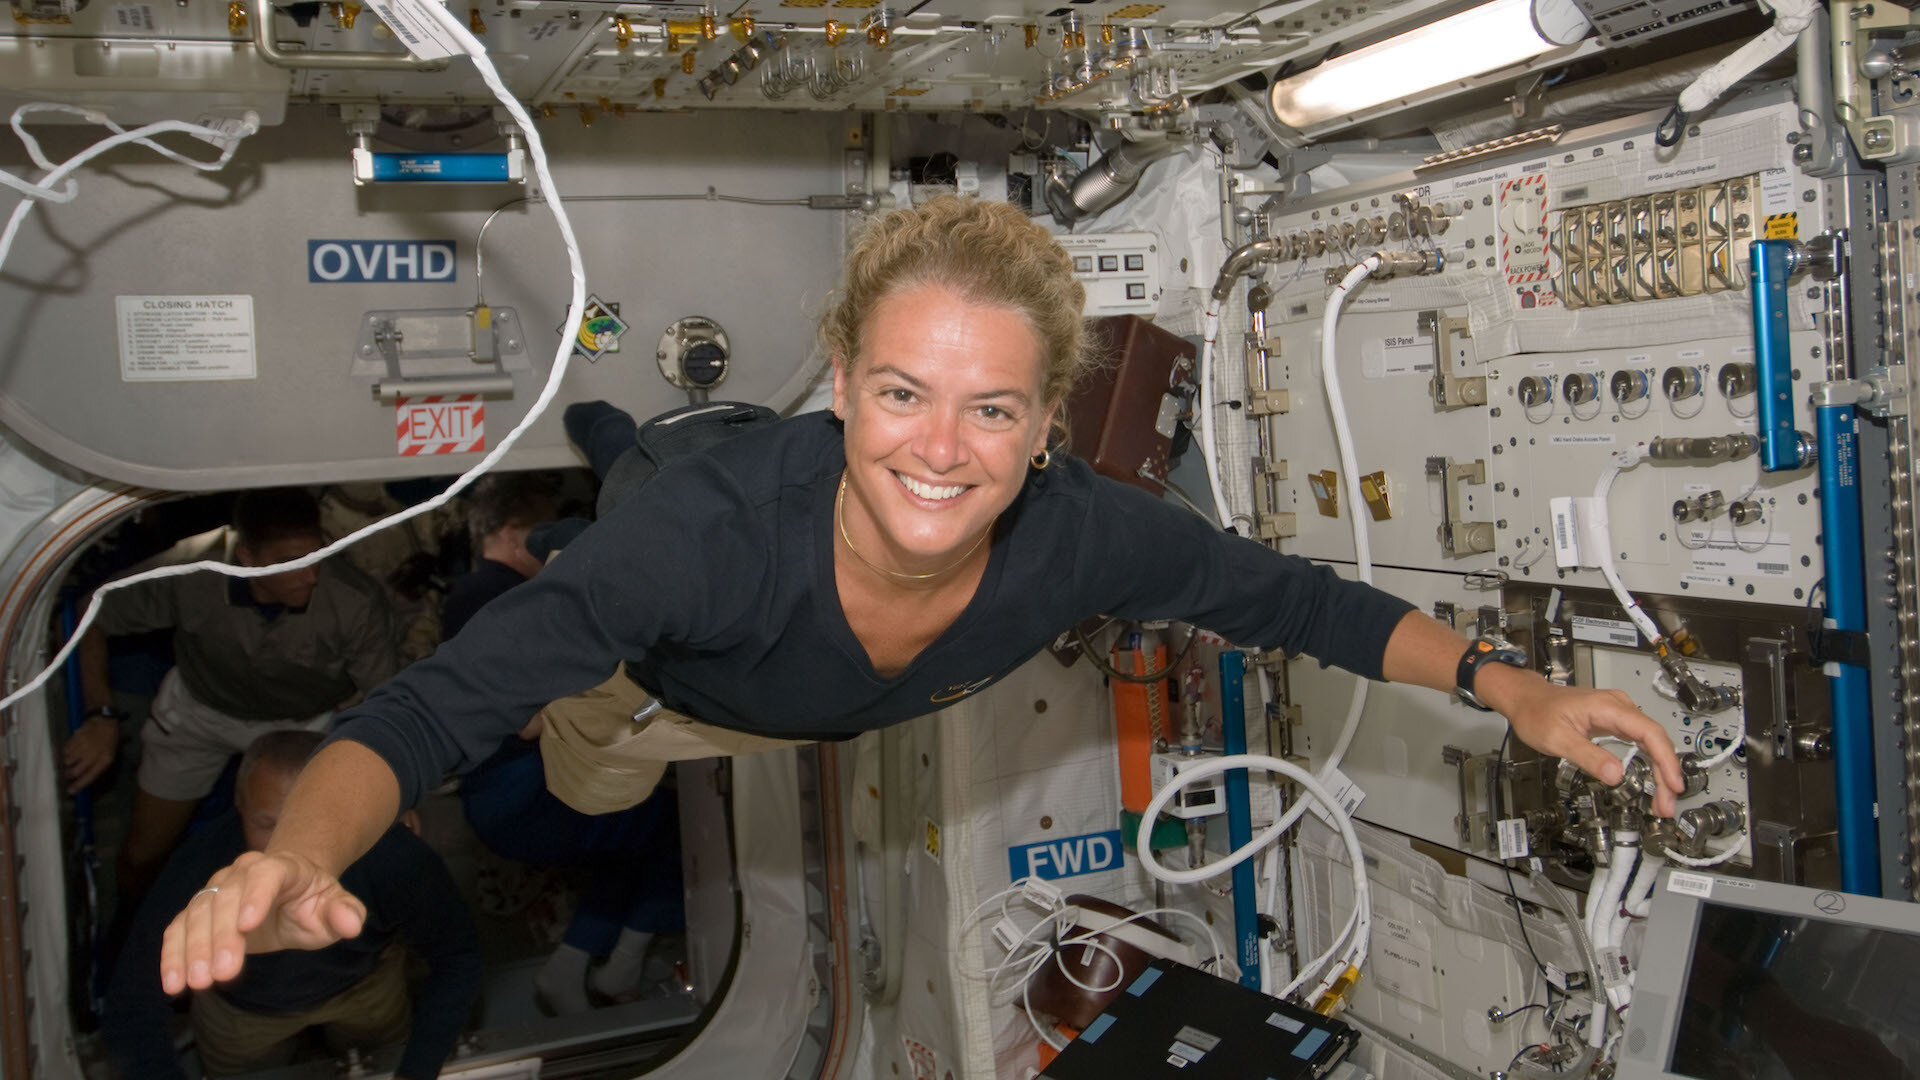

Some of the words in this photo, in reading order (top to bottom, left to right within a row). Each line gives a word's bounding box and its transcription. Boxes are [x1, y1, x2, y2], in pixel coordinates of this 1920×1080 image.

[313, 243, 454, 281] OVHD
[143, 300, 192, 309] CLOSING
[195, 300, 233, 309] HATCH
[411, 405, 470, 440] EXIT
[1026, 836, 1113, 877] FWD
